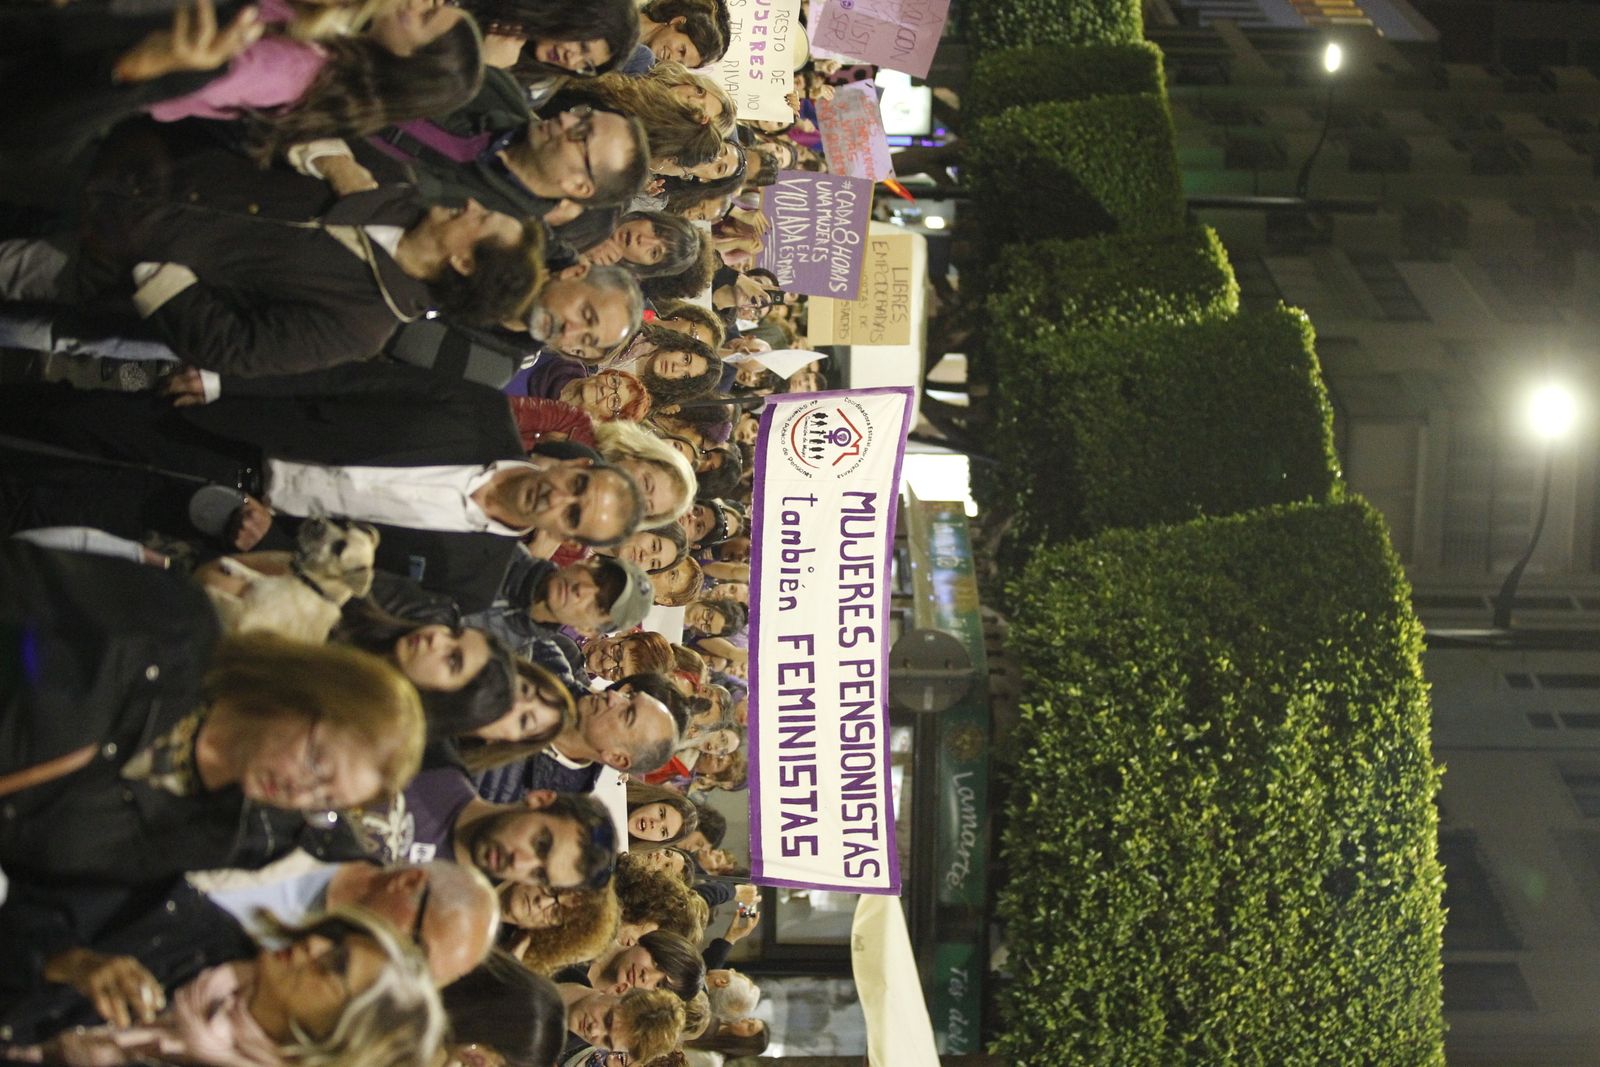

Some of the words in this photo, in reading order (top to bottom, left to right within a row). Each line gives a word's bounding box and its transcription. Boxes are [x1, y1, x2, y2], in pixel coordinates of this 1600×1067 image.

[773, 10, 790, 52] RESTO
[770, 70, 785, 86] DE
[747, 94, 760, 110] NO
[774, 178, 813, 244] VIOLADA
[816, 181, 832, 206] UNA
[834, 180, 856, 226] #CADA
[814, 209, 832, 246] MUJER
[831, 227, 860, 245] 8
[777, 246, 796, 286] ESPAÑA
[796, 244, 810, 262] EN
[812, 247, 829, 263] ES
[828, 245, 852, 292] HORAS
[869, 241, 888, 343] EMPODERADAS
[778, 493, 818, 612] también
[839, 492, 877, 648] MUJERES
[778, 634, 818, 858] FEMINISTAS
[839, 659, 880, 878] PENSIONISTAS
